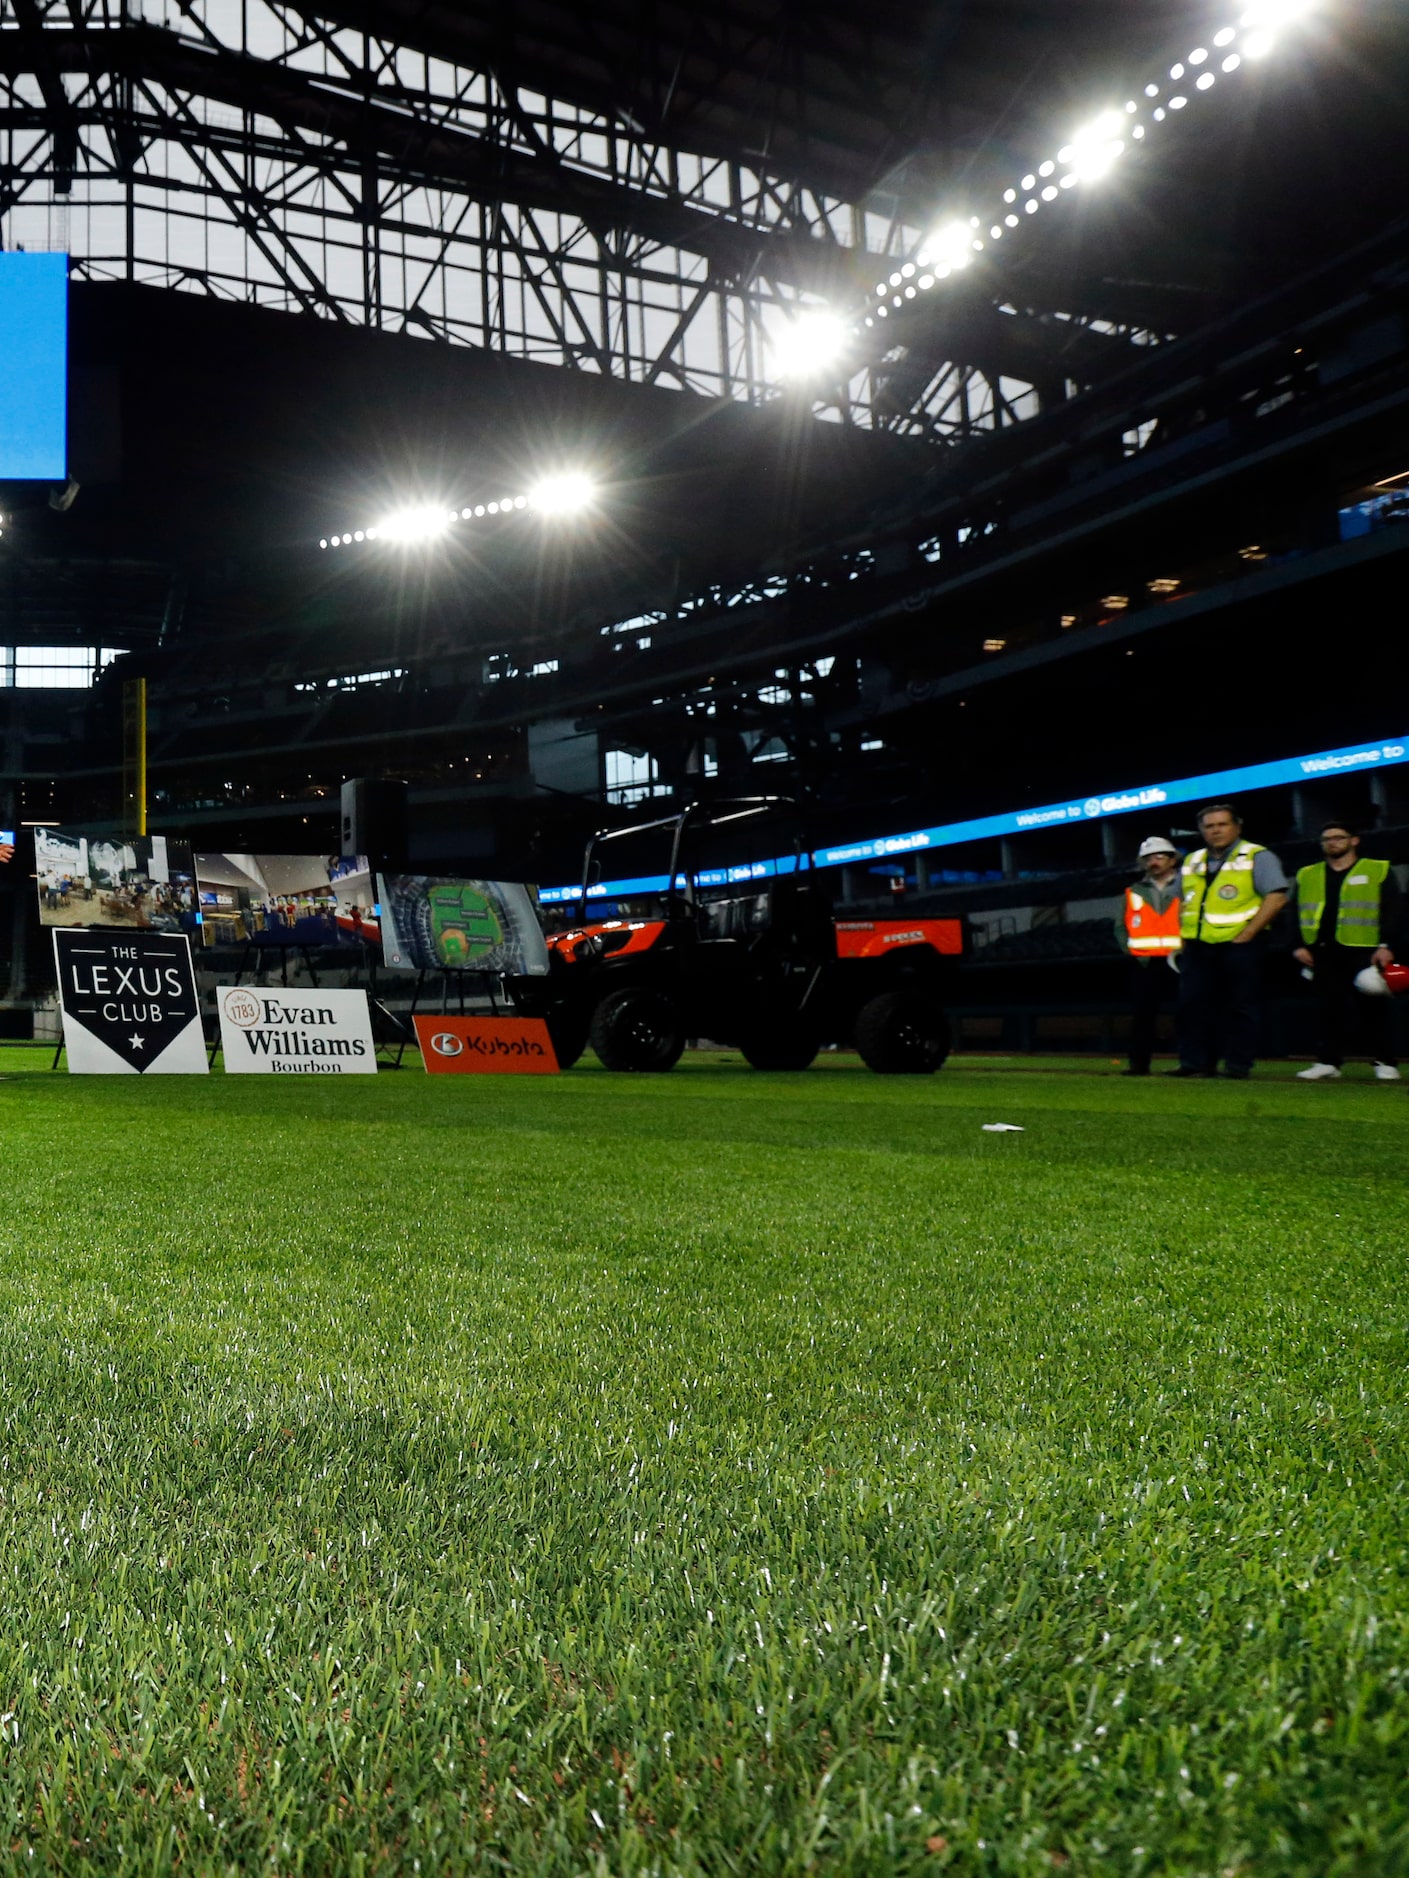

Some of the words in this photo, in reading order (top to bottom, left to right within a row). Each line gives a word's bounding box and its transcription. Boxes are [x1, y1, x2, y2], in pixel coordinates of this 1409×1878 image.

[1300, 749, 1381, 774] Welcome
[1382, 746, 1405, 758] to
[1016, 808, 1066, 827] Welcome
[1067, 806, 1081, 818] to
[1101, 793, 1139, 812] Globe
[1139, 789, 1167, 806] Life
[886, 837, 912, 853] Globe
[912, 833, 930, 848] Life
[111, 946, 138, 960] THE
[72, 965, 183, 997] LEXUS
[103, 1003, 163, 1022] CLUB
[231, 1004, 255, 1020] 1783
[261, 999, 337, 1025] Evan
[242, 1030, 366, 1056] Williams
[466, 1036, 547, 1056] Kubota
[271, 1060, 342, 1073] Bourbon
